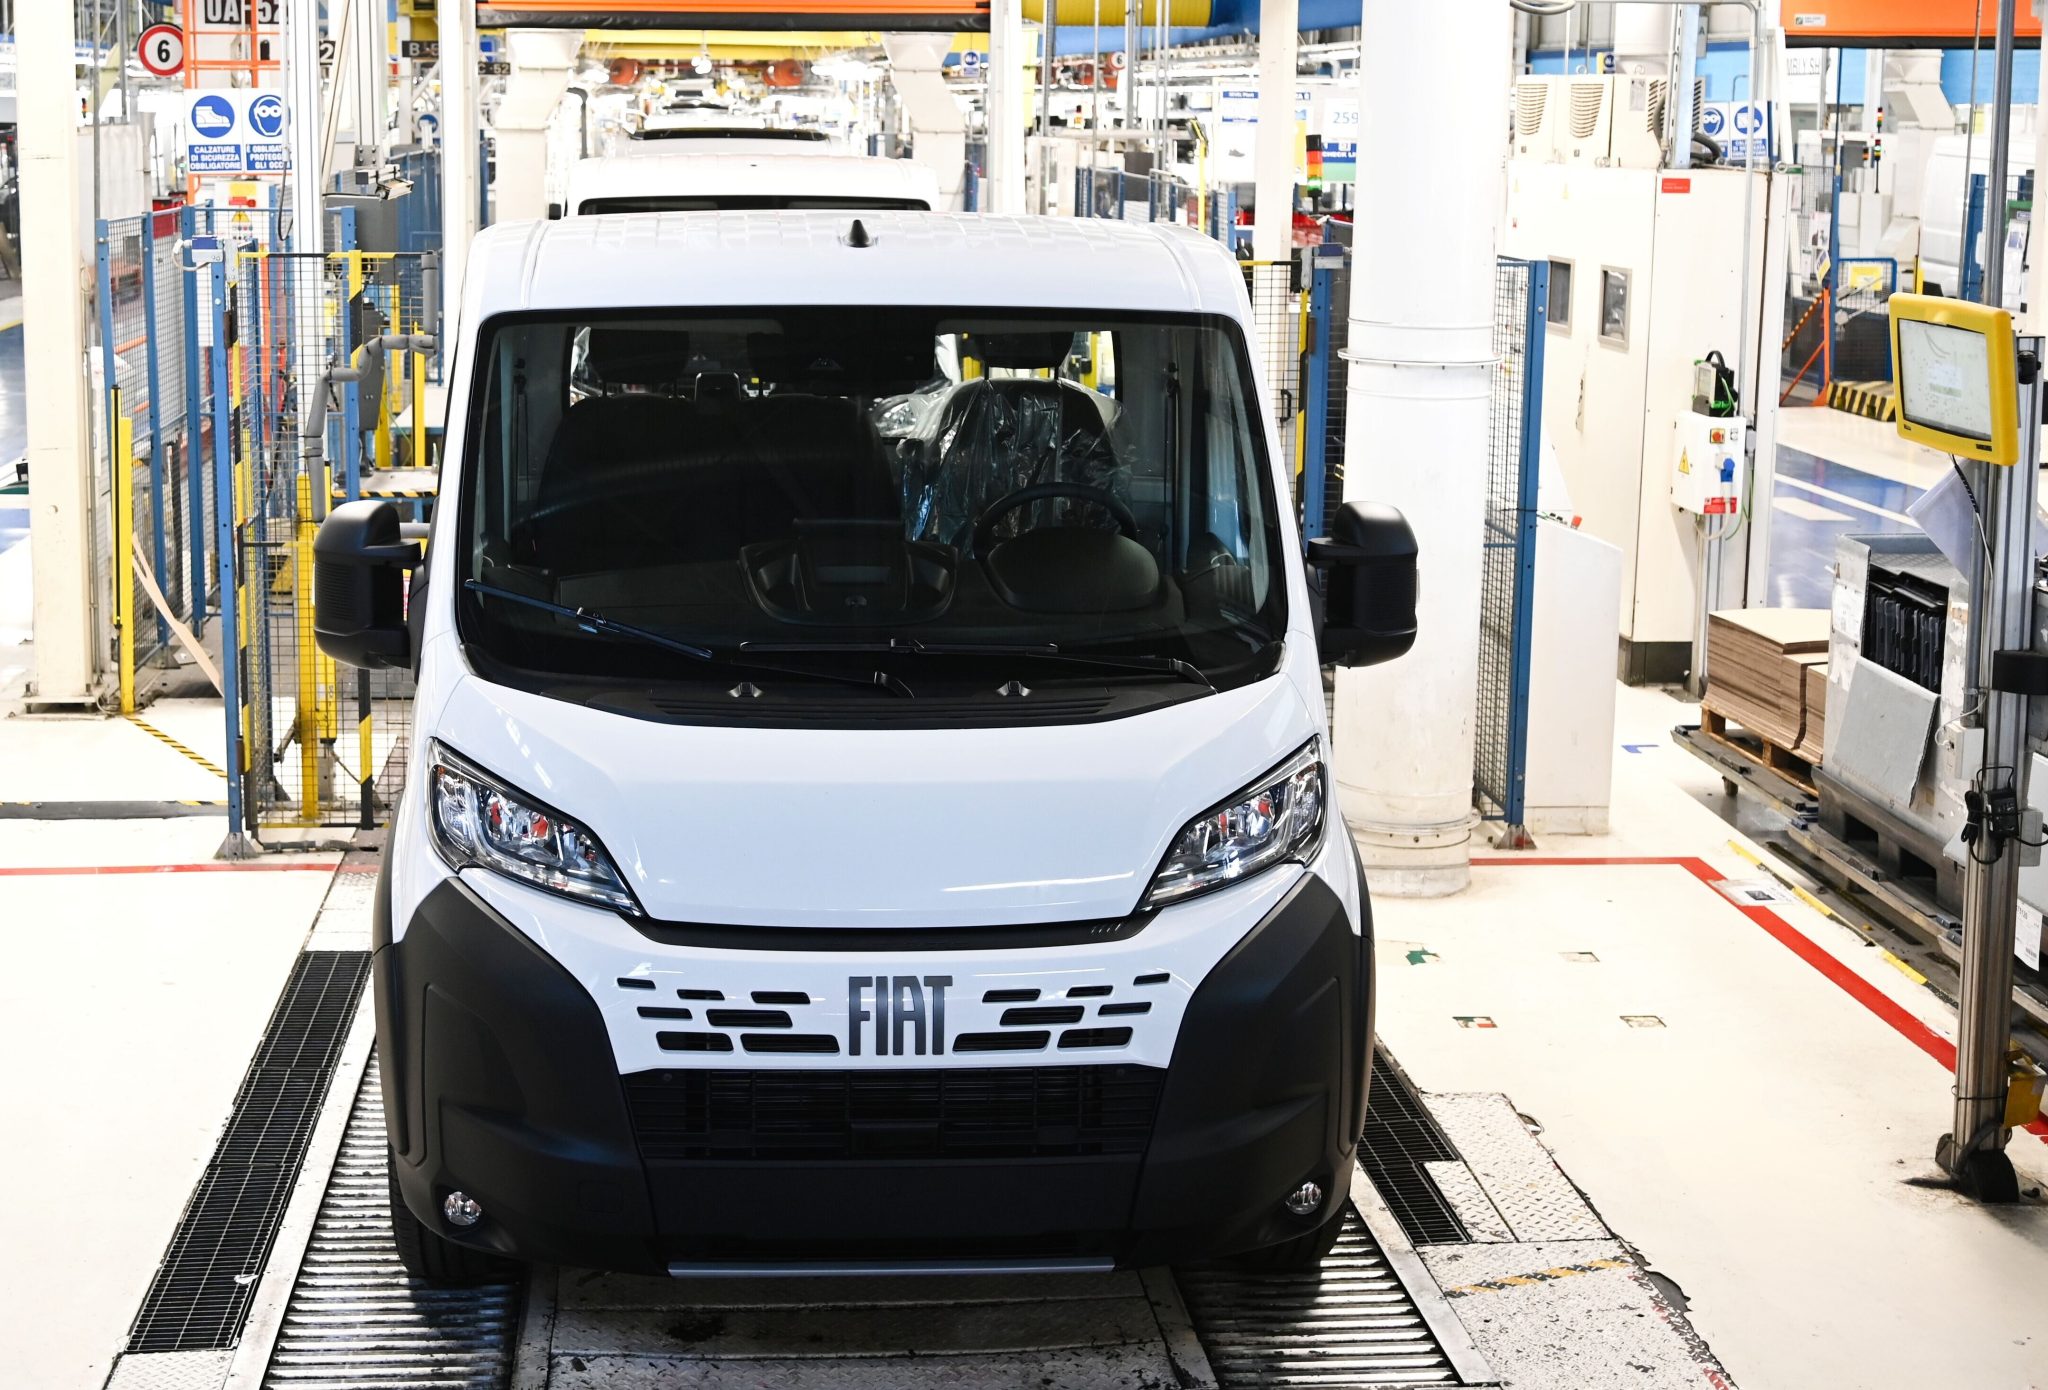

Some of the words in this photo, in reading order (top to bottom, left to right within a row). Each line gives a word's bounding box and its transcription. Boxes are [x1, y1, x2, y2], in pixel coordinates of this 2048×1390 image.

[157, 39, 171, 63] 6
[194, 145, 236, 154] CALZATURE
[252, 145, 282, 153] OBBLIGAT
[200, 153, 240, 161] SICUREZZA
[250, 153, 282, 161] PROTEGG
[190, 161, 241, 170] OBBLIGATORIE
[255, 161, 267, 169] GLI
[269, 161, 291, 169] OCCI
[848, 975, 953, 1056] FIAT
